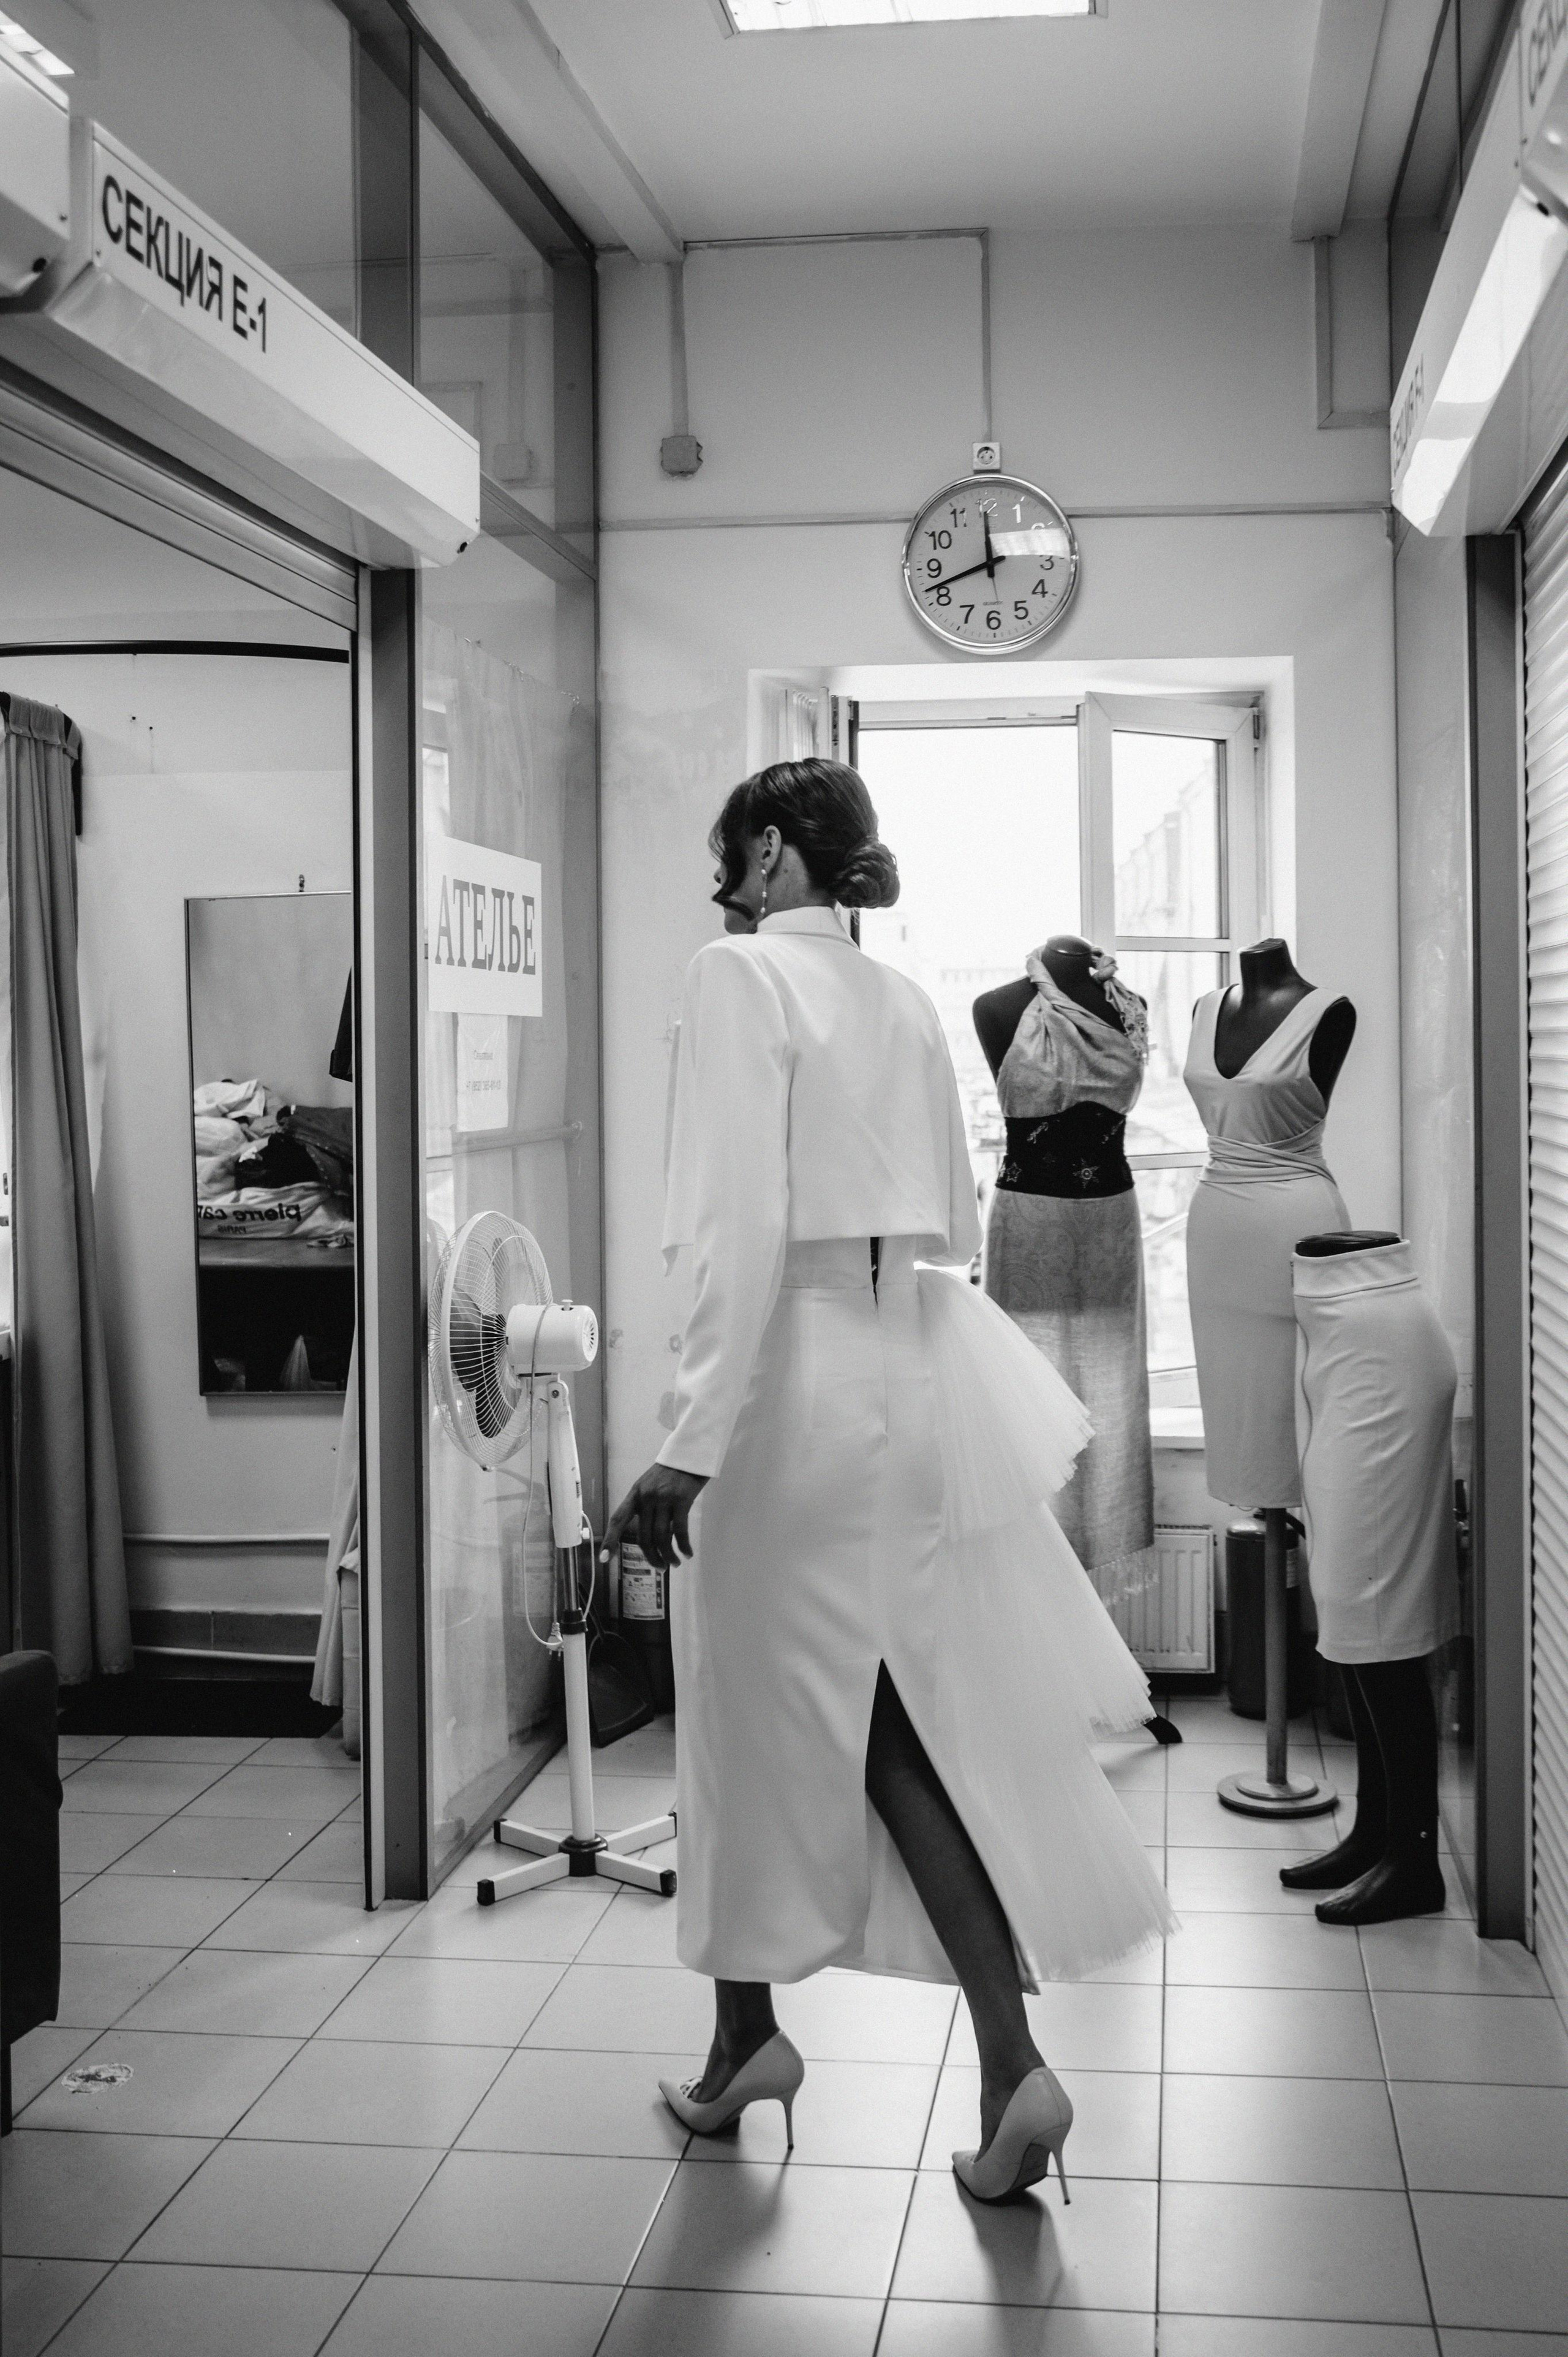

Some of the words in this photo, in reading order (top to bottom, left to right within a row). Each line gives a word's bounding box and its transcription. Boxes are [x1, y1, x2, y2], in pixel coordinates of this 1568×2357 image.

[102, 174, 223, 322] СЕКЦИЯ
[233, 273, 266, 354] Е-1
[950, 507, 967, 528] 11
[974, 498, 998, 518] 12
[1012, 503, 1022, 523] 1
[929, 530, 952, 550] 10
[926, 558, 942, 578] 9
[936, 586, 952, 606] 8
[1032, 579, 1049, 598] 4
[959, 604, 975, 624] 7
[986, 610, 1001, 630] 6
[1014, 600, 1029, 620] 5
[434, 874, 537, 976] АТЕЛЬЕ
